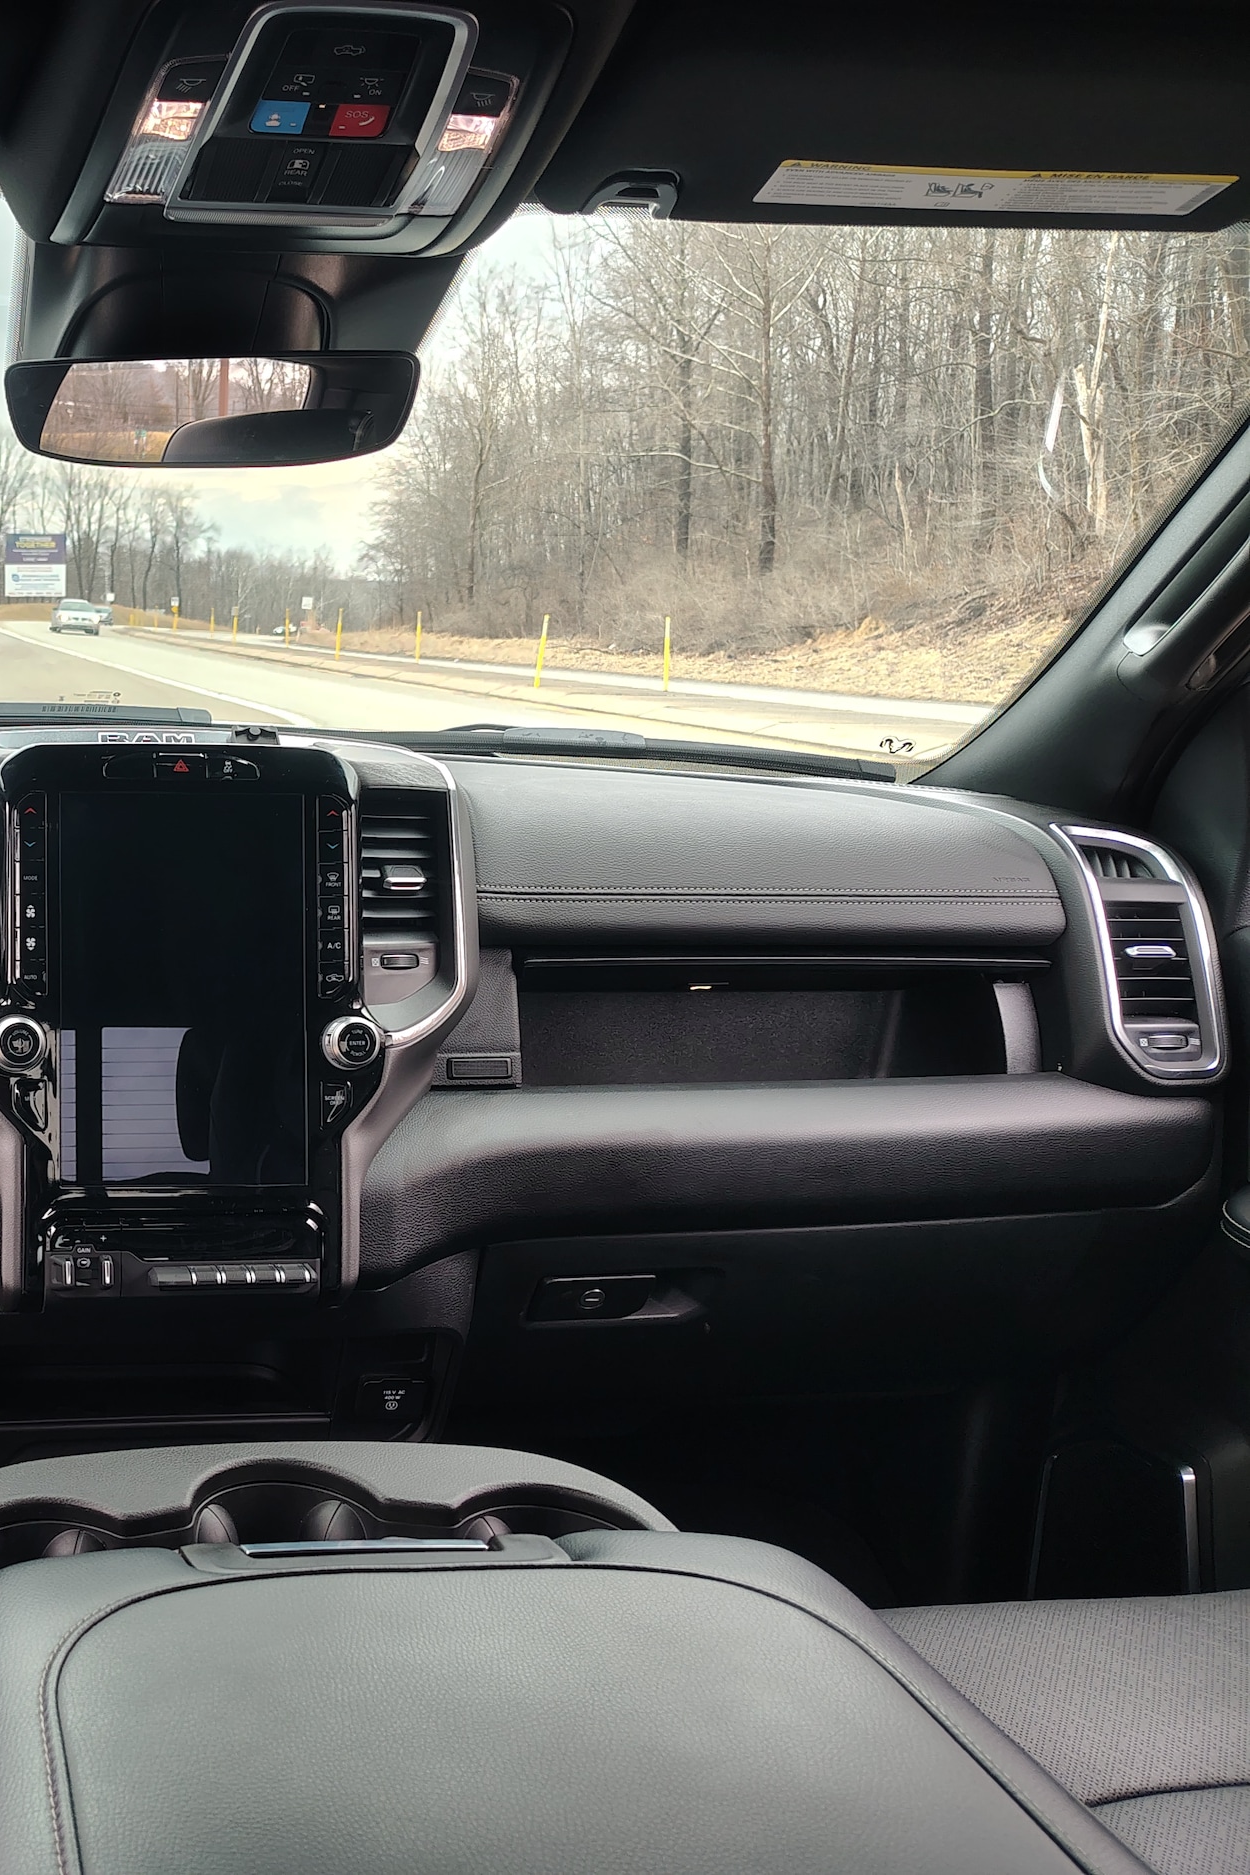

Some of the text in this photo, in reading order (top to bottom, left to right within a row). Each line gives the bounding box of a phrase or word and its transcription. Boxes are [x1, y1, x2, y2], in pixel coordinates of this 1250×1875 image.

[282, 84, 300, 92] OFF
[345, 110, 369, 118] SOS
[810, 162, 871, 171] WARNING
[284, 169, 308, 177] REAR
[98, 731, 195, 744] RAM
